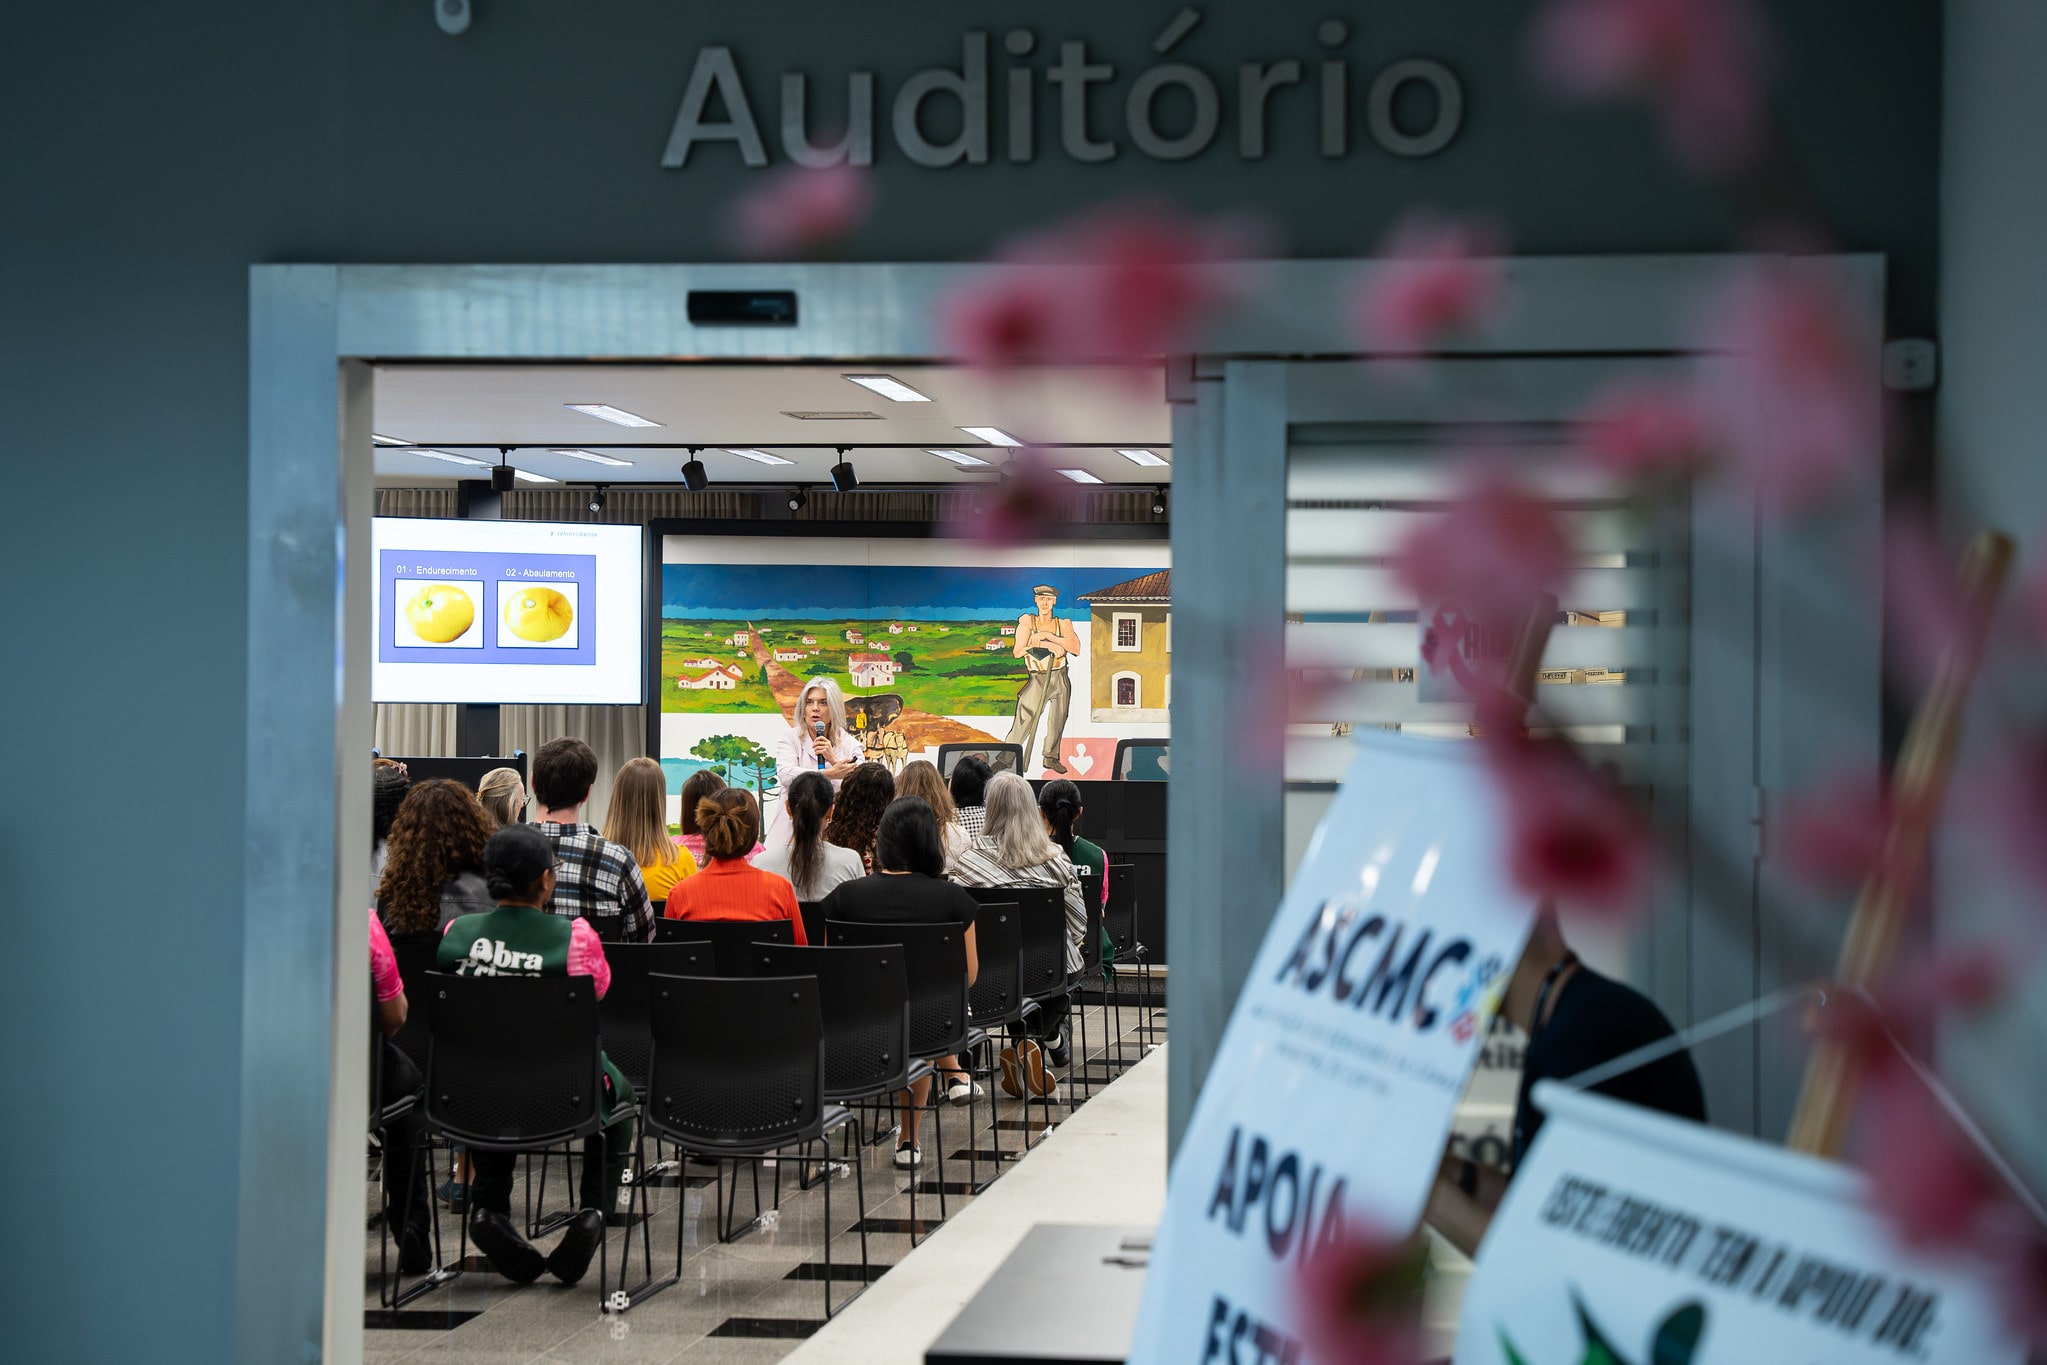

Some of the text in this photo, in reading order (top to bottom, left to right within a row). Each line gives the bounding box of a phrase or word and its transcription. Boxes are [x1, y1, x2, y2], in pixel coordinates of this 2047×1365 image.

[660, 6, 1466, 170] Auditório
[396, 564, 407, 574] 01
[416, 565, 478, 576] Endurecimento
[505, 568, 516, 577] 02
[522, 568, 576, 578] Abaulamento
[1275, 898, 1474, 1032] ASCMC
